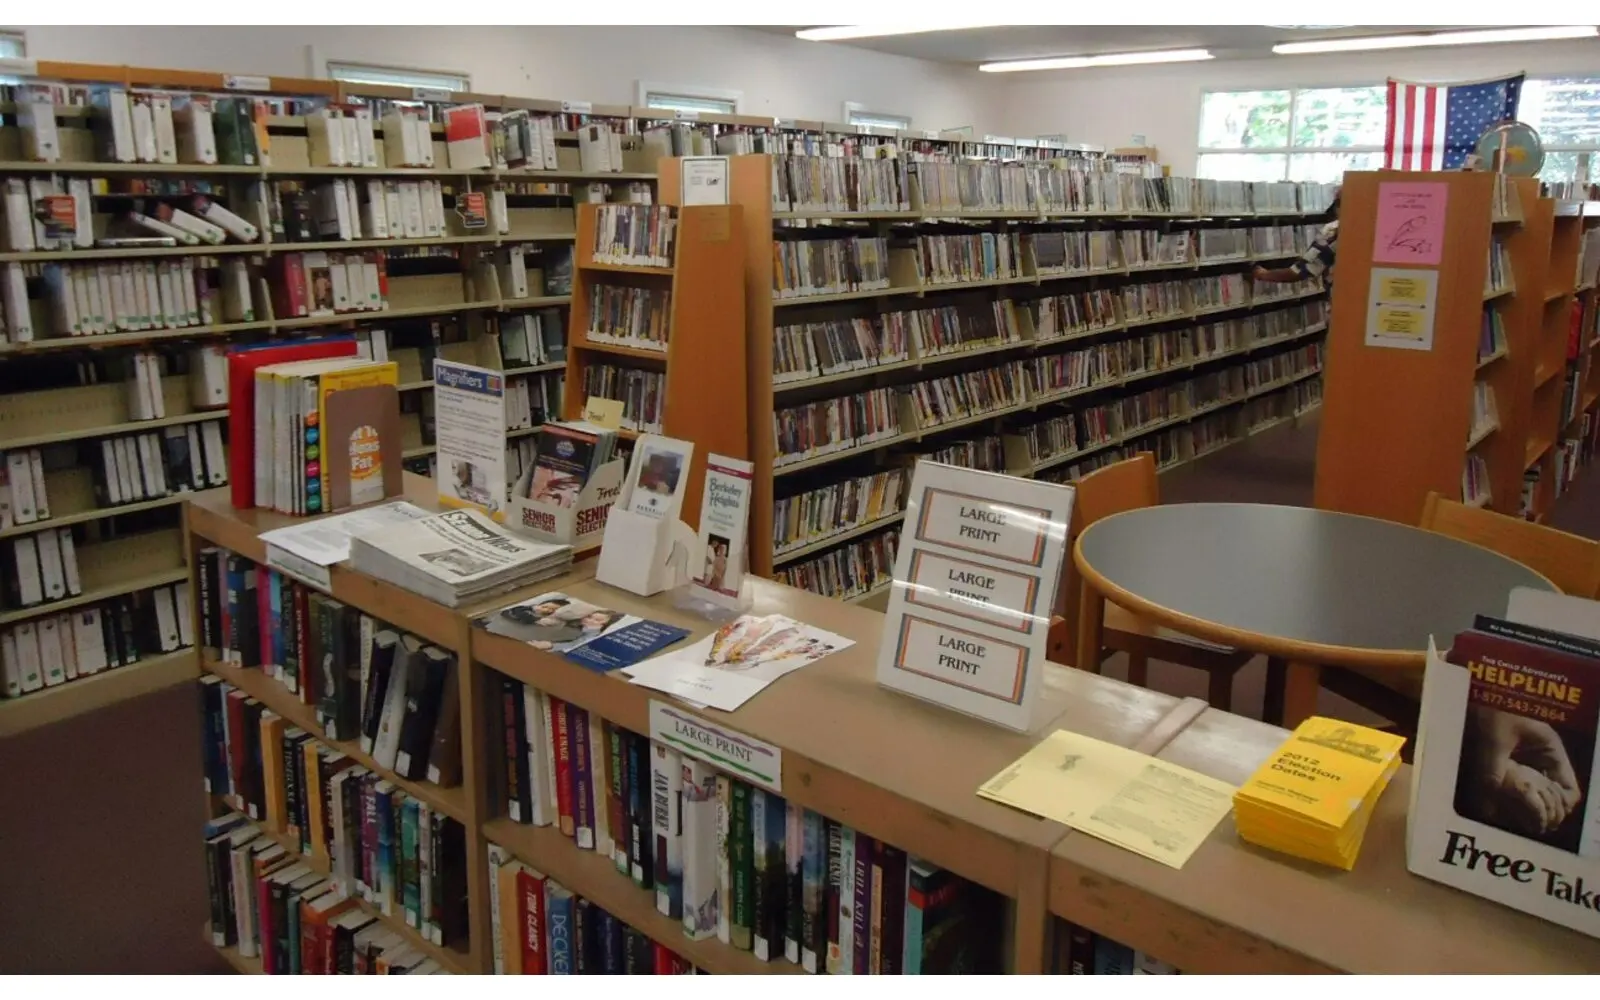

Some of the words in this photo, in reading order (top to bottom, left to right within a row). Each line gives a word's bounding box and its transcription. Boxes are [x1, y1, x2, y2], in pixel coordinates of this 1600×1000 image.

[437, 364, 483, 389] Magnifiers
[522, 507, 556, 526] SENIOR
[576, 501, 615, 526] SENIO
[960, 506, 1007, 526] LARGE
[959, 525, 1002, 544] PRINT
[949, 568, 996, 590] LARGE
[938, 634, 987, 658] LARGE
[938, 653, 981, 676] PRINT
[1467, 660, 1583, 705] HELPLINE
[675, 721, 713, 748] LARGE
[716, 734, 754, 763] PRINT
[1277, 757, 1342, 782] Election
[1283, 752, 1320, 766] 2012
[1271, 763, 1316, 782] Dates
[365, 796, 377, 824] FALL
[1439, 829, 1537, 883] Free
[526, 891, 538, 914] TOM
[526, 915, 539, 953] CLANCY
